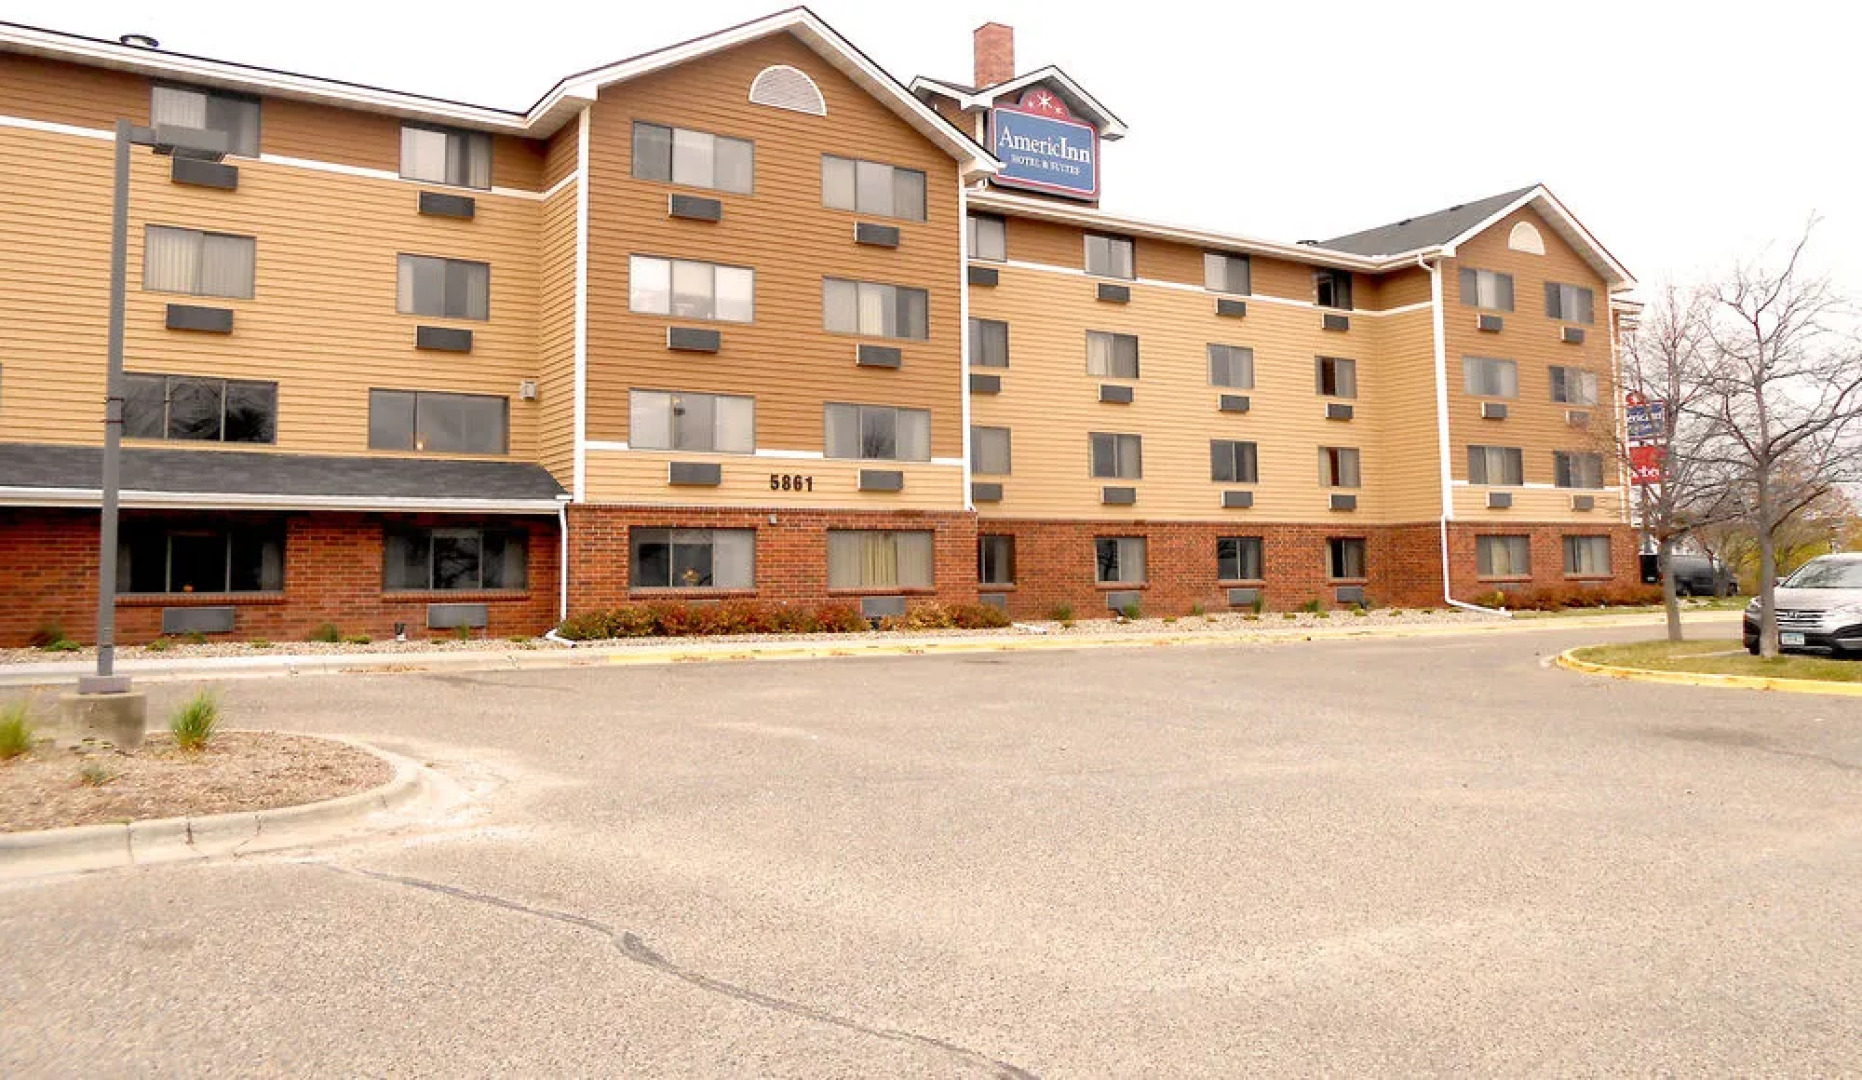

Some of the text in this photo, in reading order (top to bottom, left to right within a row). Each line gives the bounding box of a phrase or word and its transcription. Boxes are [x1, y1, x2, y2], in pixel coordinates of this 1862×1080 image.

[998, 125, 1091, 164] AmericInn
[1011, 154, 1041, 168] HOTEL
[770, 474, 813, 493] 5861
